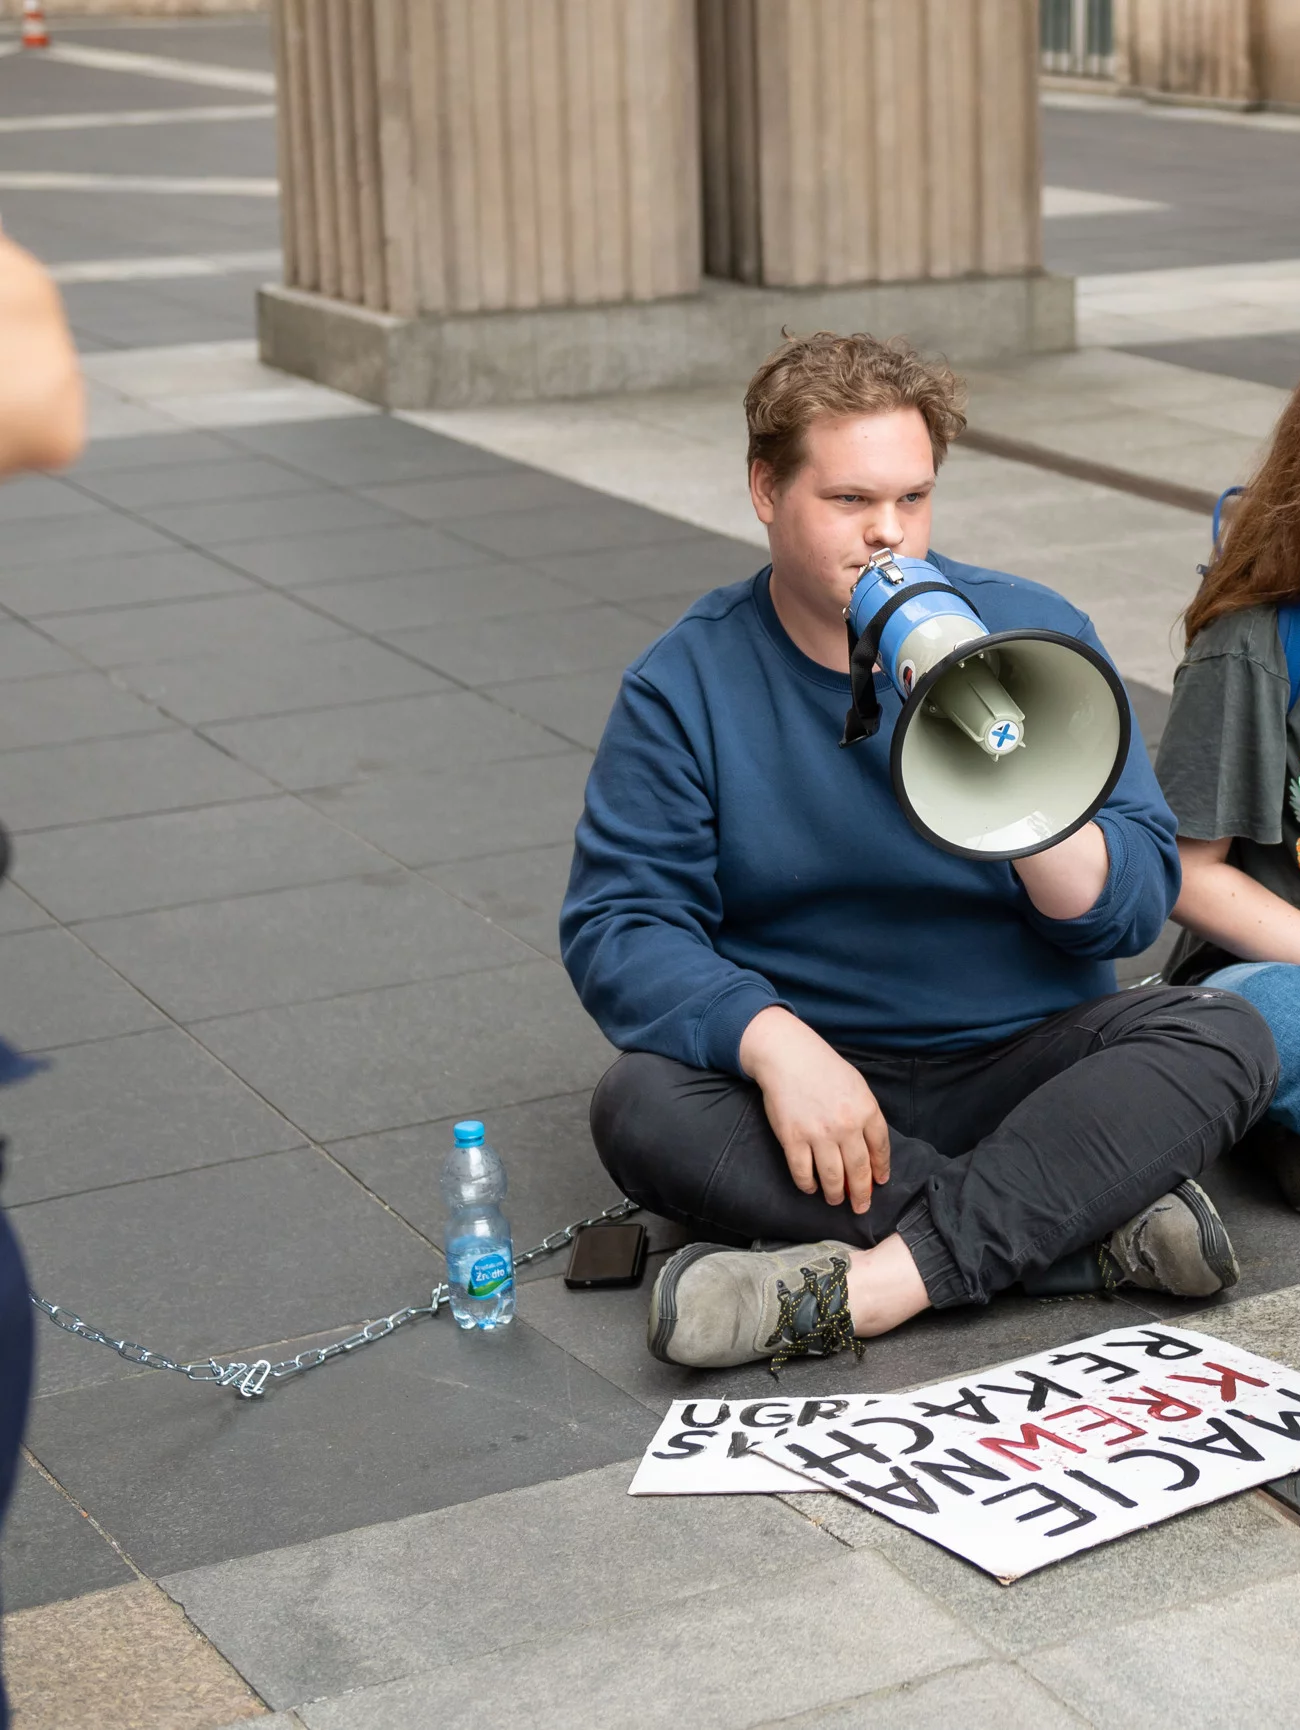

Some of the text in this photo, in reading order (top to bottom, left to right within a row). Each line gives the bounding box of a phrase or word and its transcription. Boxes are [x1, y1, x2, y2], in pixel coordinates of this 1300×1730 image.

[681, 1399, 882, 1428] UGR
[785, 1330, 1203, 1478] RĘKACH
[843, 1361, 1270, 1514] KREW NA
